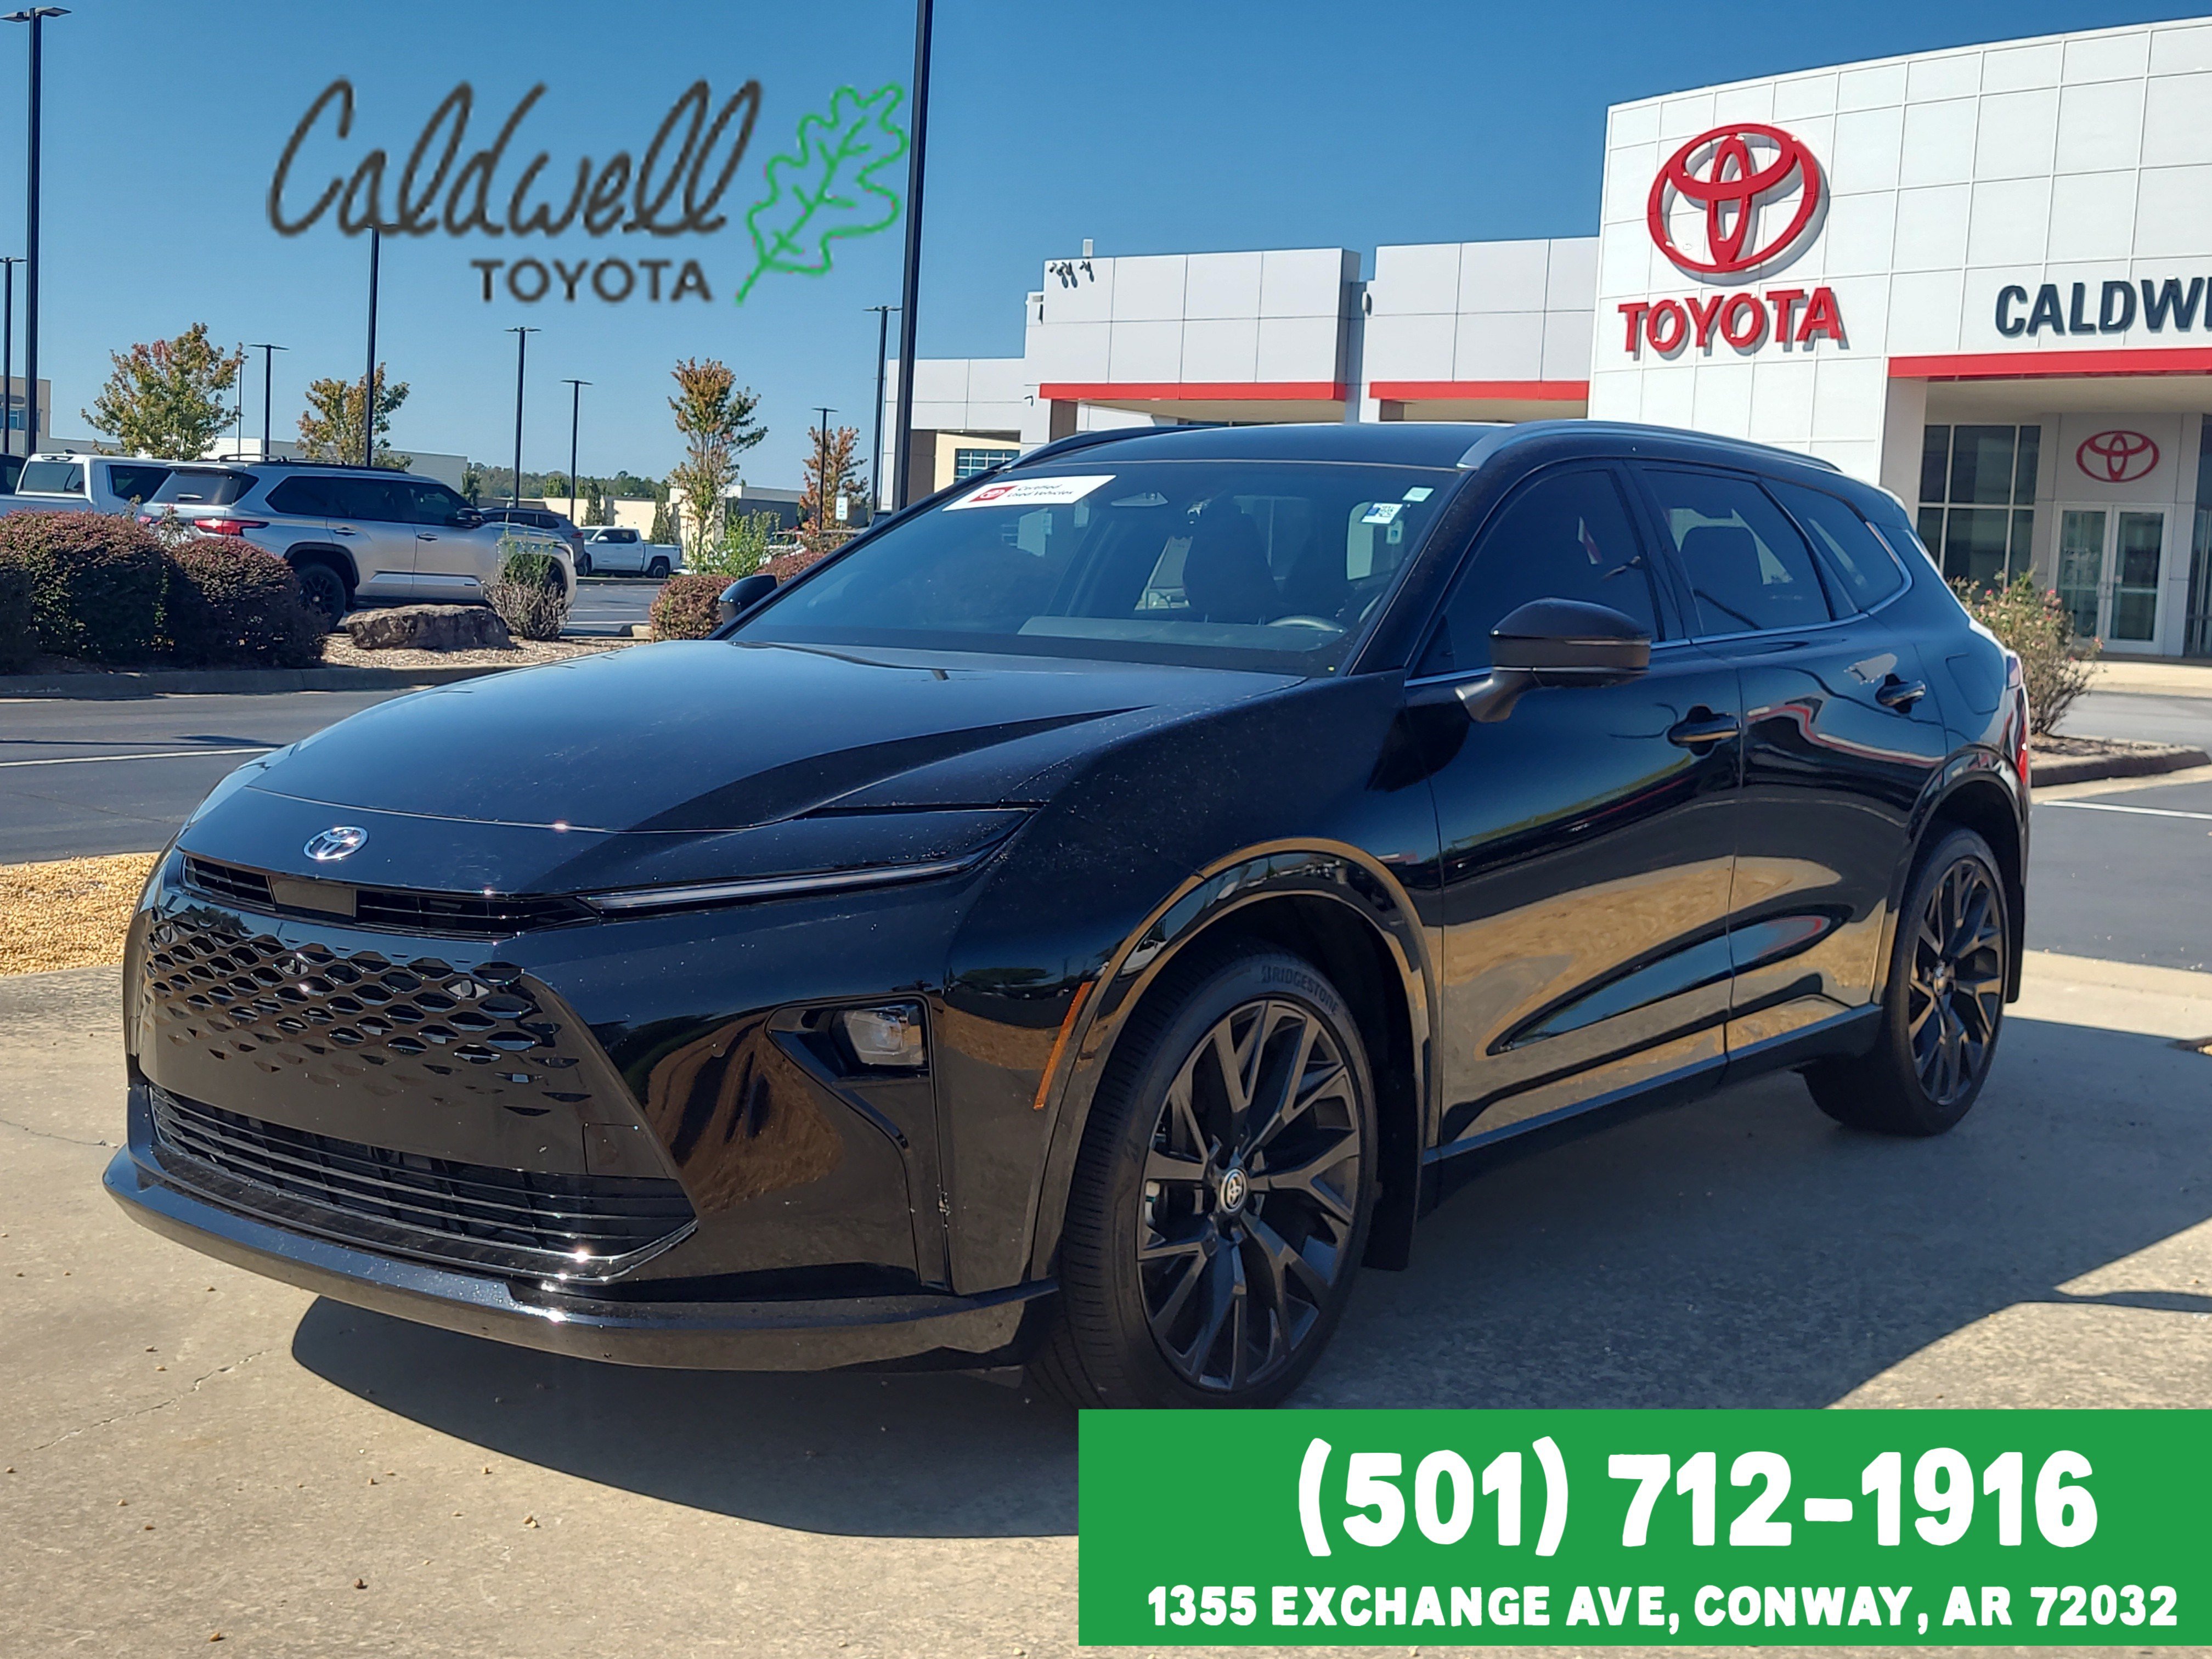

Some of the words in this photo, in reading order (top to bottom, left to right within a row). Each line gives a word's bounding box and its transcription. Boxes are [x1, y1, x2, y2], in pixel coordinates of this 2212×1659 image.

[1618, 287, 1842, 352] TOYOTA
[1995, 276, 2212, 336] CALDW
[1261, 964, 1339, 1014] BRIDGESTONE
